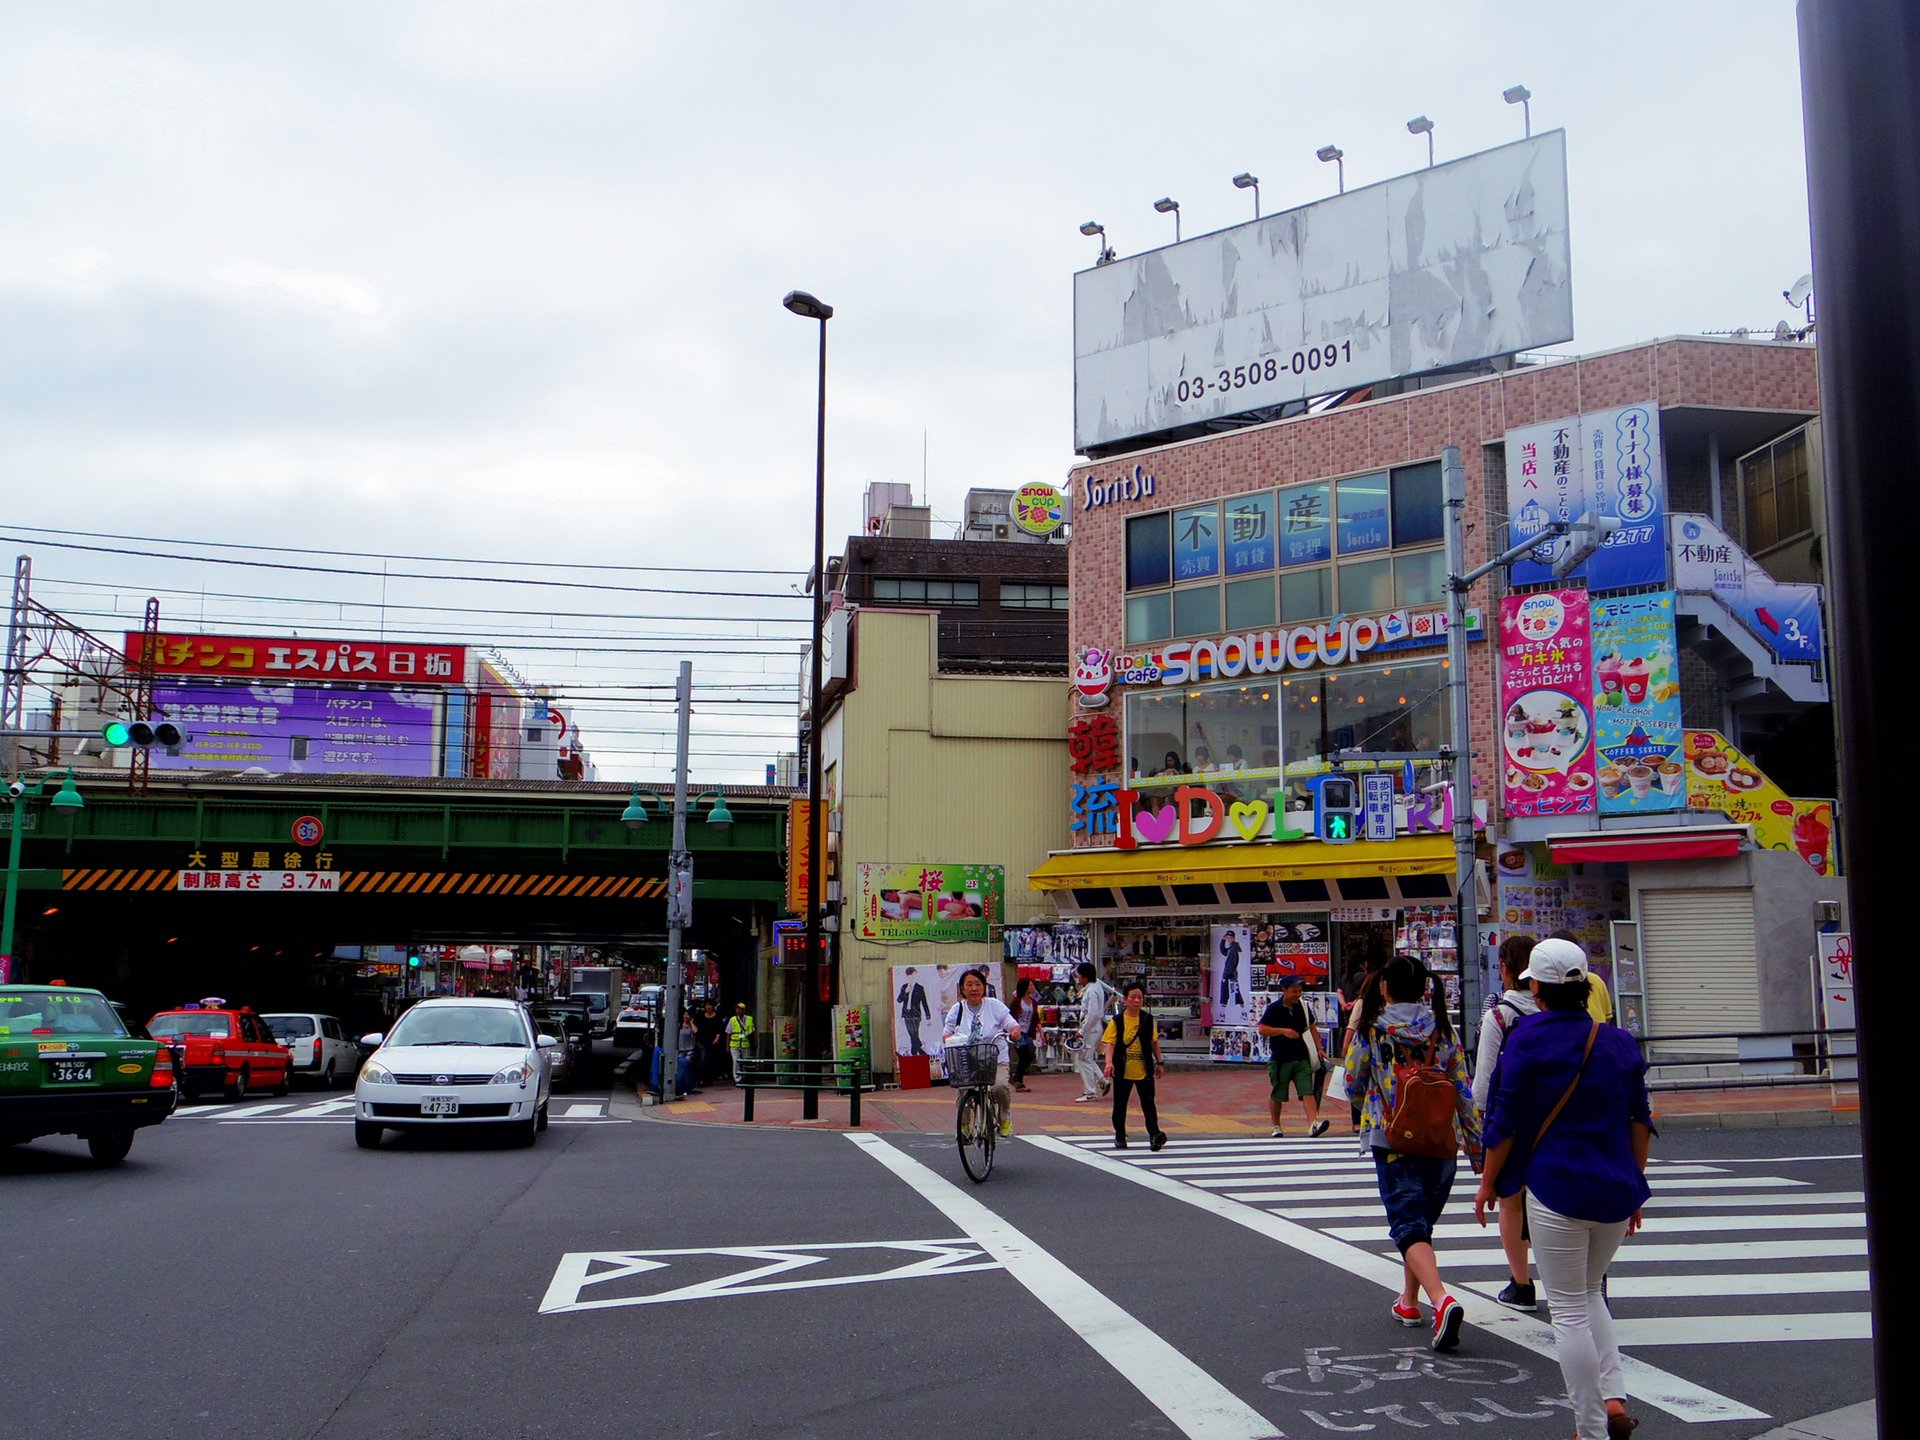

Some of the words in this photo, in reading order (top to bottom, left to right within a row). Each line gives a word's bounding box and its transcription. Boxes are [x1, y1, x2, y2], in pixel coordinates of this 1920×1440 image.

[1177, 340, 1352, 402] 03-3508-0091
[1521, 443, 1538, 490] 当店へ
[1625, 414, 1645, 514] オーナー様募集
[1179, 494, 1324, 551] 不動産
[1181, 555, 1211, 576] 売買
[1235, 547, 1266, 567] 賃貸
[1288, 538, 1322, 559] 管理
[1677, 544, 1733, 564] 不動産
[1605, 600, 1659, 616] モヒート
[139, 637, 254, 668] パチンコ
[1115, 653, 1153, 670] IDOL
[1521, 649, 1566, 667] カキ氷
[326, 698, 373, 710] パチンコ
[1595, 704, 1653, 716] NON-ALCOHOL
[1648, 719, 1679, 730] SERIES
[1604, 747, 1635, 757] COFFEE
[1638, 745, 1667, 755] SERIES
[1367, 780, 1380, 814] 自転車
[1379, 780, 1391, 814] 歩行者
[1374, 813, 1386, 836] 専用
[1731, 810, 1764, 821] ワッフル
[188, 850, 334, 870] 大型最徐行
[183, 872, 262, 890] 制限高さ
[918, 868, 945, 893] 桜
[966, 880, 979, 889] 2F
[57, 1068, 92, 1081] 36-64
[428, 1102, 457, 1113] 47-38
